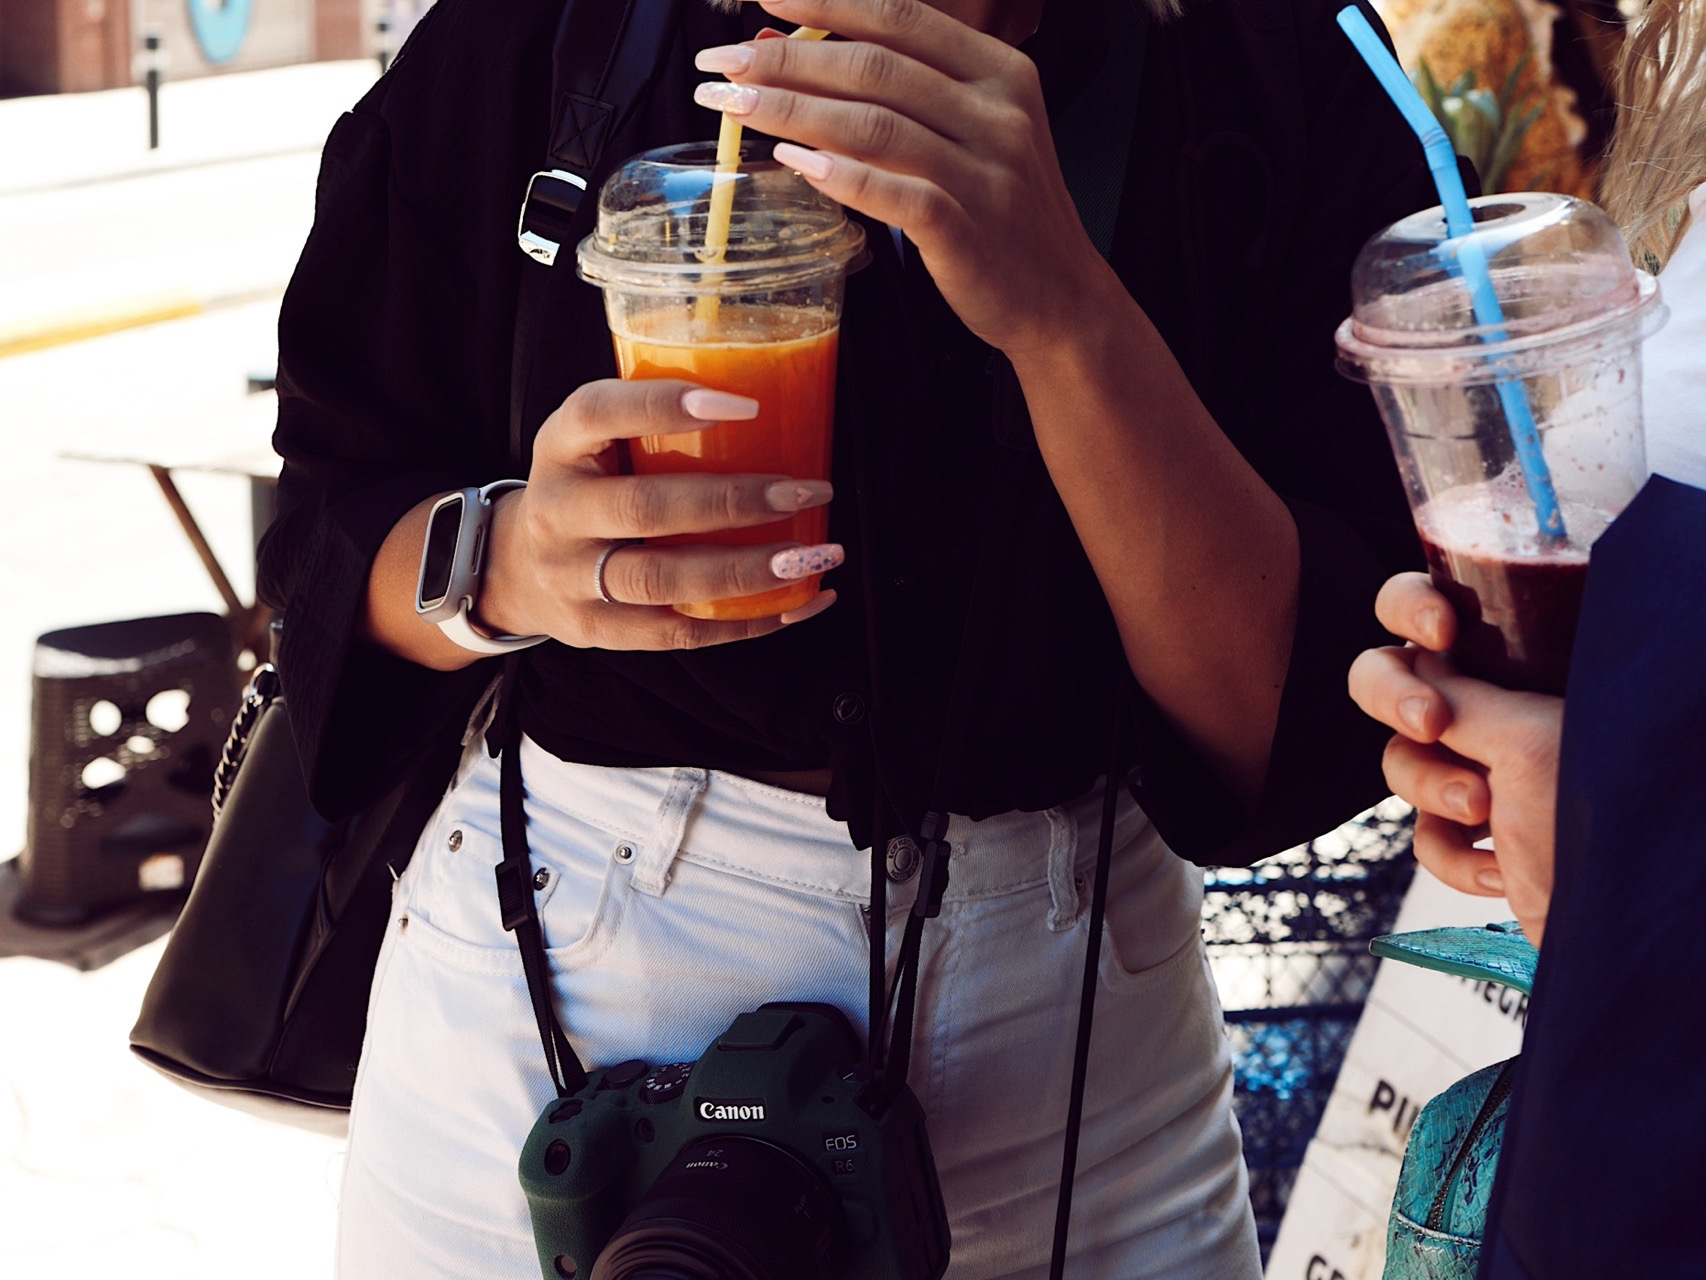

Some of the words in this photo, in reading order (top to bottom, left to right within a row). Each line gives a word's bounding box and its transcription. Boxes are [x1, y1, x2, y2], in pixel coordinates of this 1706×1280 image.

[700, 1102, 764, 1120] Canon
[825, 1134, 857, 1151] EOS
[835, 1159, 855, 1172] R6
